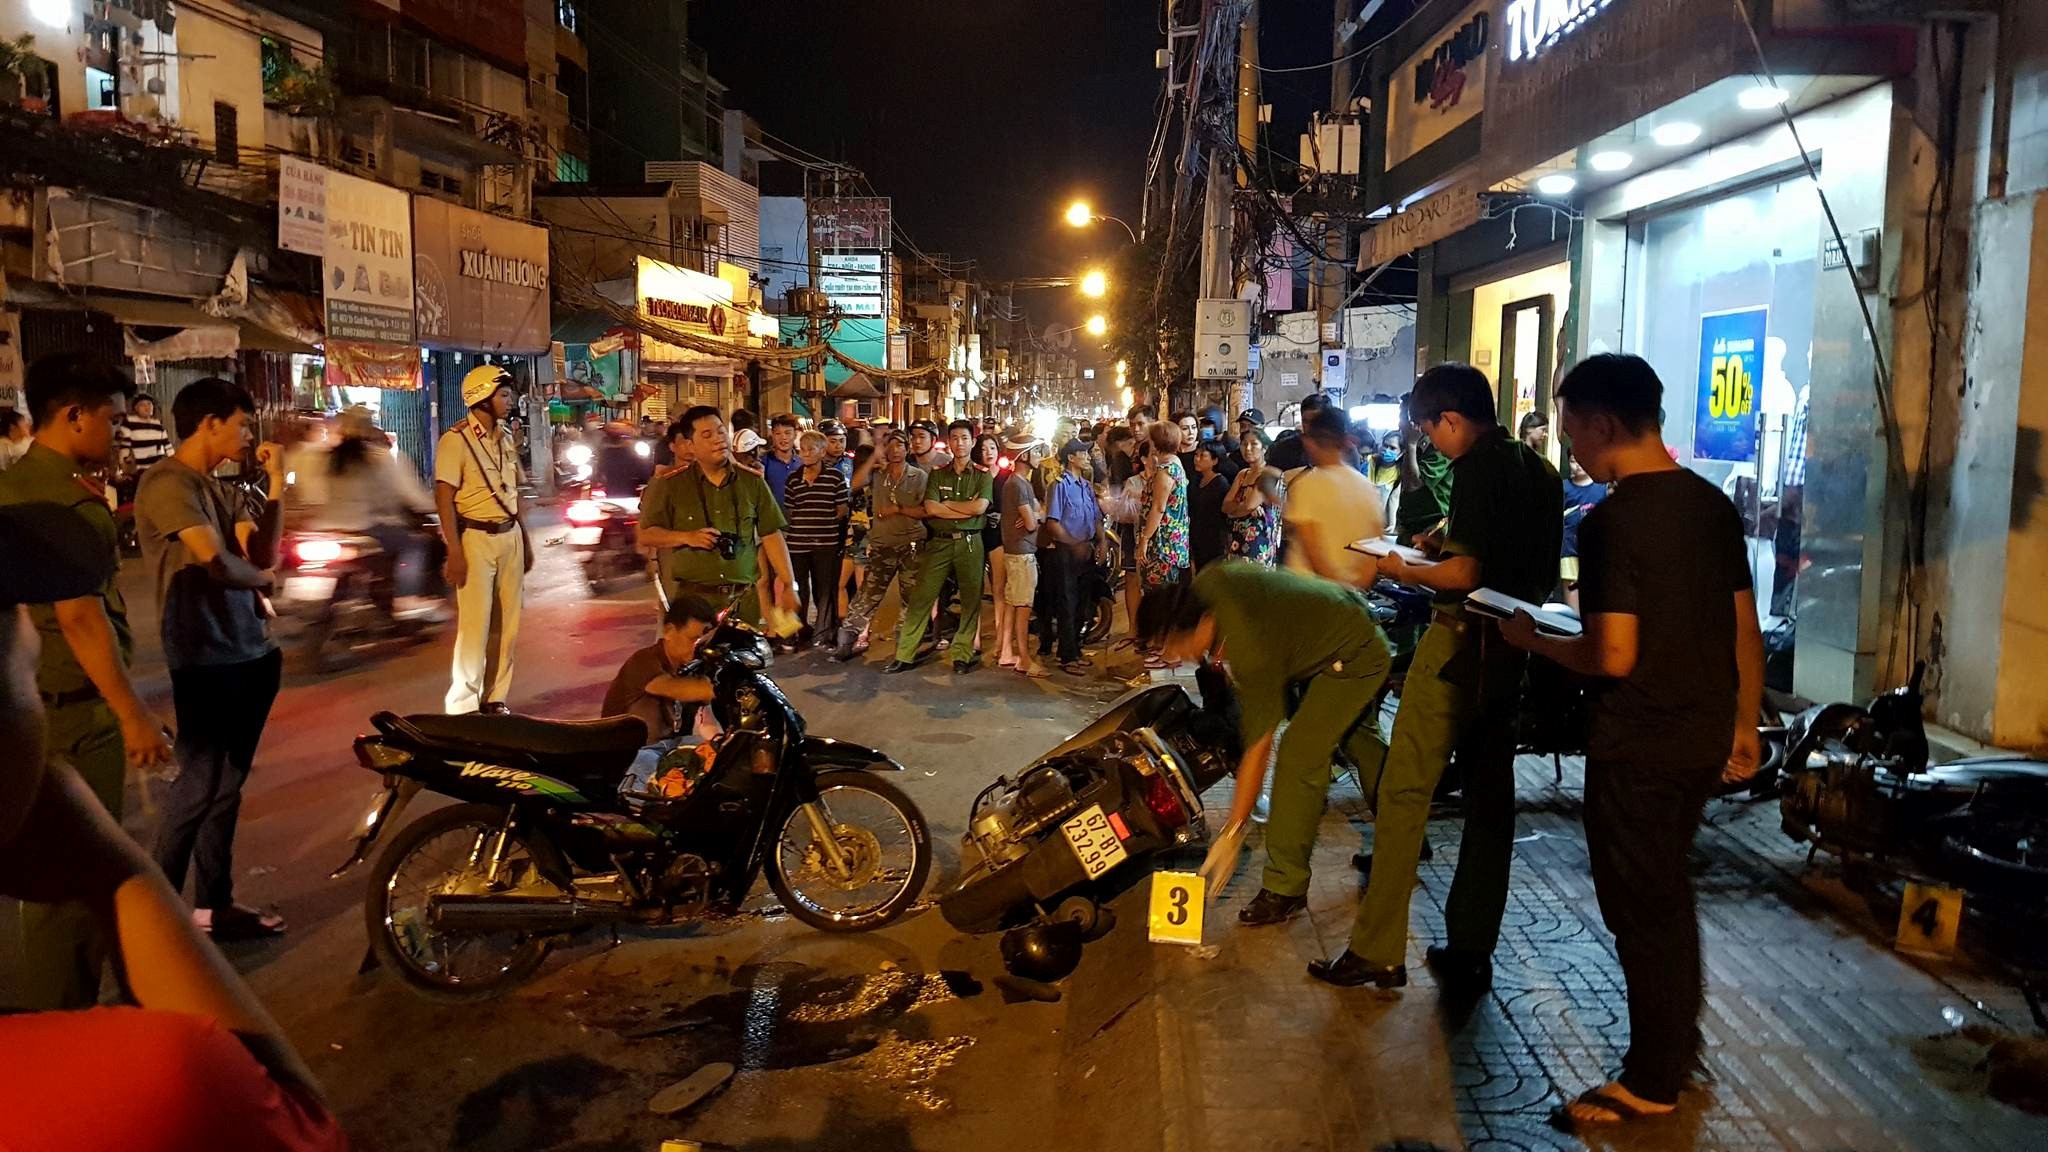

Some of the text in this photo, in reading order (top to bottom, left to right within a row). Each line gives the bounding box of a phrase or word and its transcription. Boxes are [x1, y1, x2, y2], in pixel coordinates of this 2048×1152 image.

[350, 221, 376, 254] TIN
[380, 228, 404, 259] TIN
[460, 761, 539, 781] Wave
[1167, 886, 1189, 926] 3
[1911, 898, 1939, 938] 4
